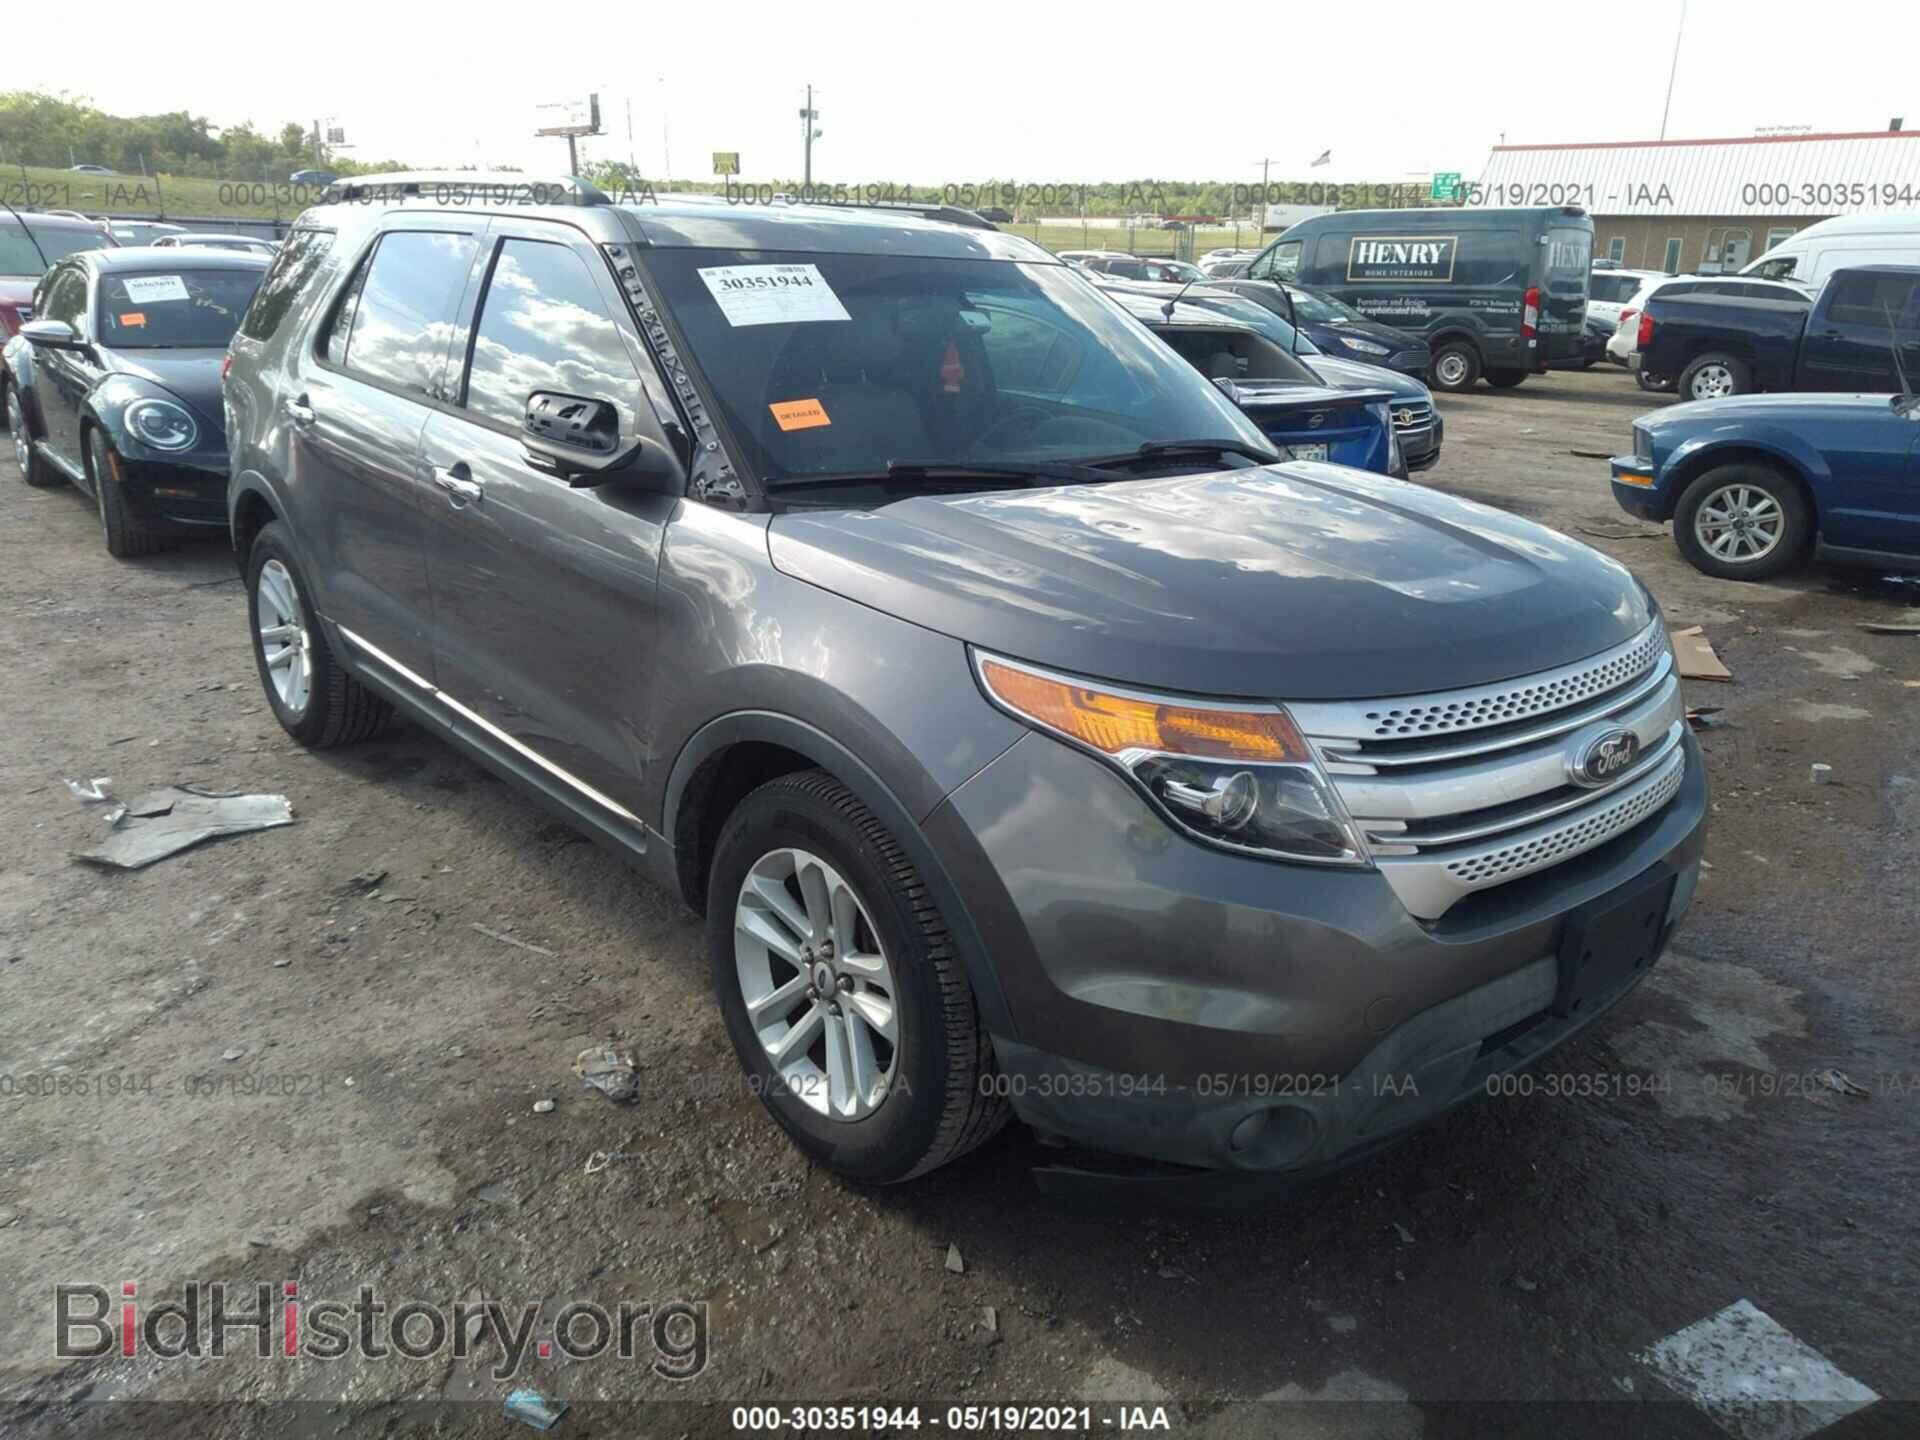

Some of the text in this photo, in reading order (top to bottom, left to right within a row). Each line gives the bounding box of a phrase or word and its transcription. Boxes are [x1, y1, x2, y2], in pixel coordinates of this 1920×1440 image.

[1357, 242, 1447, 264] HENRY
[1364, 269, 1434, 277] HOME INTERIORS
[718, 274, 814, 291] 30351944
[780, 409, 821, 420] DETAILED
[1598, 737, 1631, 774] Ford
